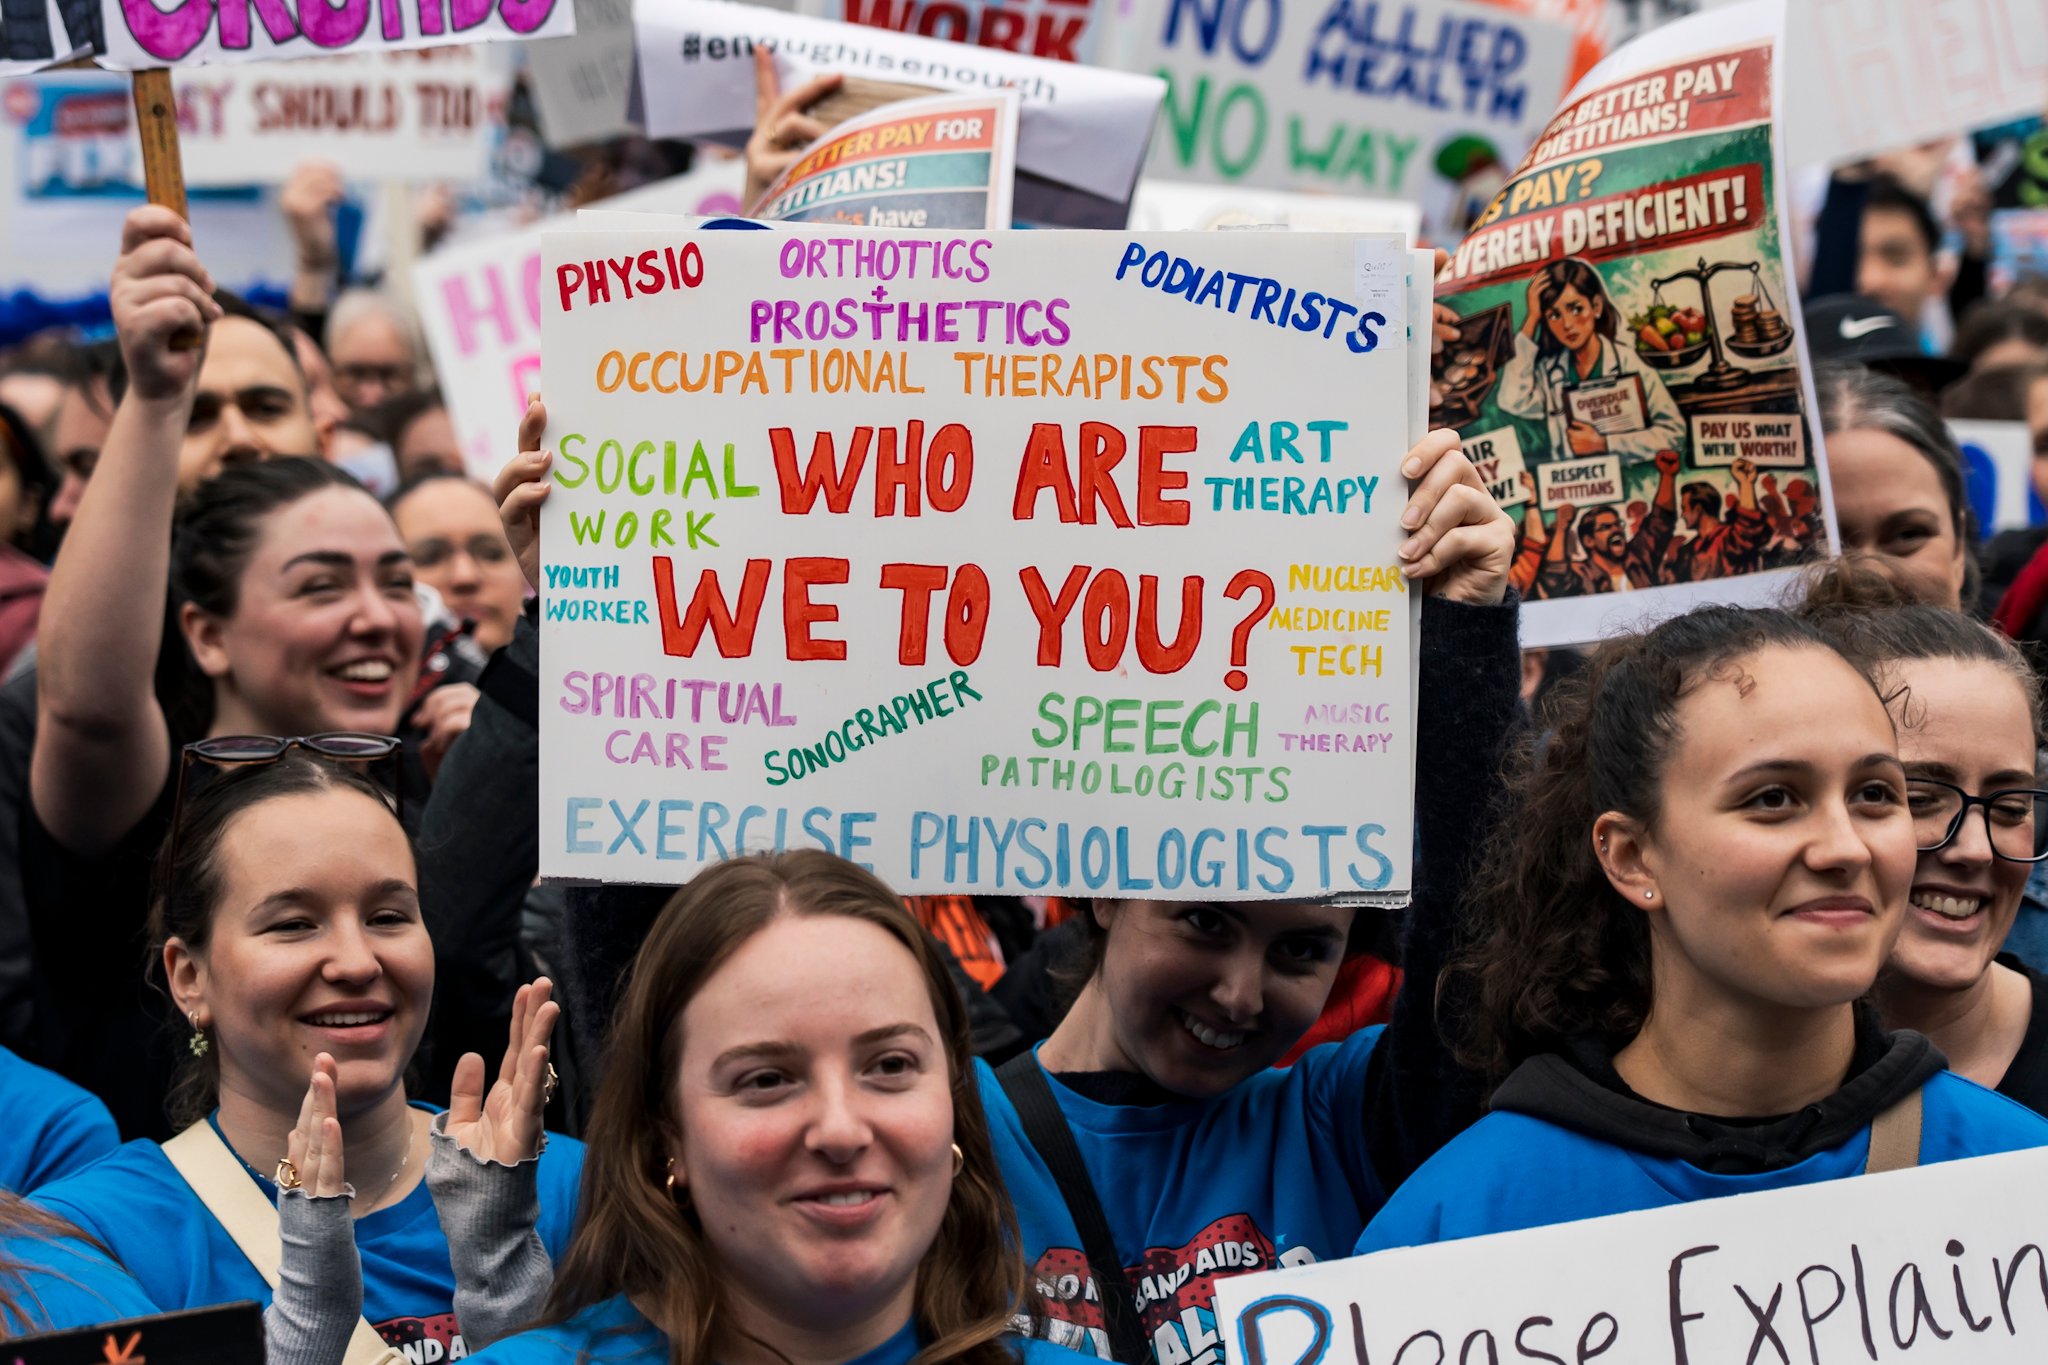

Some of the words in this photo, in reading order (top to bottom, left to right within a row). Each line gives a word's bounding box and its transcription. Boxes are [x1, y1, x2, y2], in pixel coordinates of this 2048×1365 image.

[1161, 0, 1282, 65] NO
[1575, 76, 1667, 127] BETTER
[1673, 58, 1741, 100] PAY
[878, 120, 932, 150] PAY
[934, 117, 983, 142] FOR
[1156, 68, 1269, 180] NO
[1288, 115, 1418, 191] WAY
[1533, 100, 1690, 164] DIETITIANS!
[1509, 159, 1604, 215] PAY?
[869, 201, 928, 227] have
[1437, 215, 1556, 285] EVERELY
[1562, 175, 1748, 256] DEFICIENT!
[557, 241, 704, 311] PHYSIO
[779, 238, 992, 283] ORTHOTICS
[1115, 242, 1386, 353] PODIATRISTS
[750, 297, 1071, 346] PROSTHETICS
[597, 348, 925, 395] OCCUPATIONAL
[954, 351, 1229, 404] THERAPISTS
[1229, 420, 1349, 463] ART
[1700, 422, 1728, 439] PAY
[1732, 421, 1752, 438] US
[1754, 423, 1792, 437] WHAT
[1701, 443, 1735, 457] WE'RE
[1740, 441, 1797, 458] WORTH!
[553, 433, 760, 500] SOCIAL
[769, 419, 974, 518] WHO
[1012, 421, 1197, 529] ARE
[1551, 464, 1607, 484] RESPECT
[1204, 475, 1379, 515] THERAPY
[1547, 480, 1615, 501] DIETITIANS
[570, 508, 720, 550] WORK
[544, 564, 619, 590] YOUTH
[1288, 563, 1406, 593] NUCLEAR
[546, 598, 650, 625] WORKER
[652, 556, 849, 661] WE
[880, 563, 990, 667] TO
[1268, 606, 1391, 632] MEDICINE
[1290, 645, 1383, 678] TECH
[559, 670, 797, 727] SPIRITUAL
[1304, 703, 1390, 725] MUSIC
[764, 670, 983, 786] SONOGRAPHER
[1031, 692, 1259, 758] SPEECH
[1278, 733, 1393, 753] THERAPY
[604, 729, 729, 771] CARE
[981, 754, 1292, 803] PATHOLOGISTS
[565, 797, 877, 875] EXERCISE
[910, 811, 1393, 893] PHYSIOLOGISTS
[1196, 1241, 1259, 1276] AIDS
[1668, 1238, 2048, 1365] Explain
[402, 1338, 444, 1365] ND
